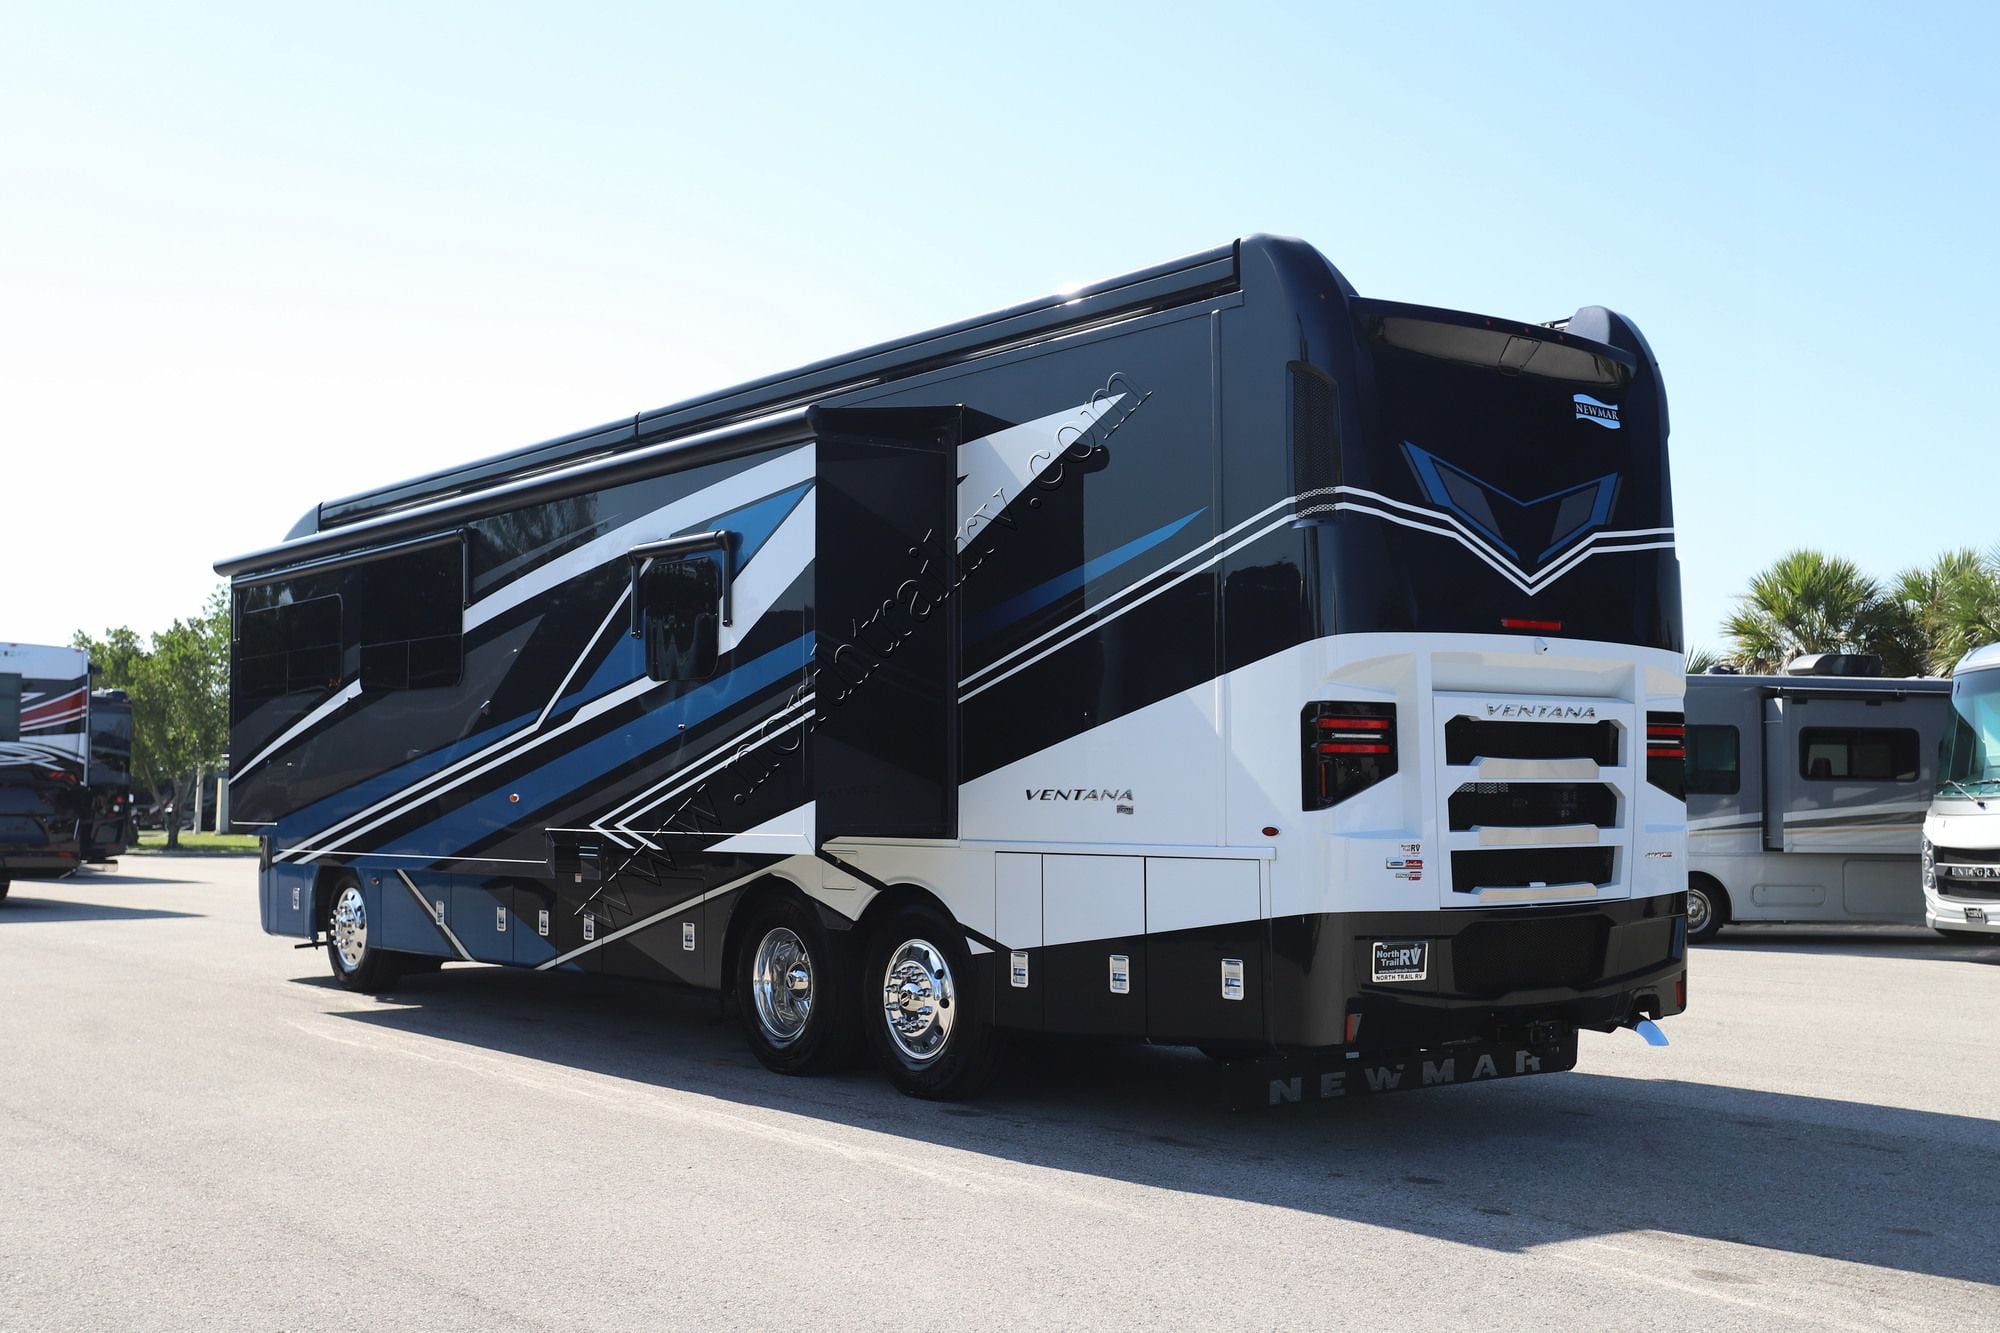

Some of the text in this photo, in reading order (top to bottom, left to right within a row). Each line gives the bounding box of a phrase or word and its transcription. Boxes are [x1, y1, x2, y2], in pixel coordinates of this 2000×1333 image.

[1575, 403, 1619, 420] NEWMAR
[1486, 703, 1596, 718] VENTANA
[1025, 789, 1134, 801] VENTANA
[1376, 949, 1421, 965] North RV
[1380, 958, 1400, 967] Trail
[1269, 1051, 1541, 1105] NEWMAR
